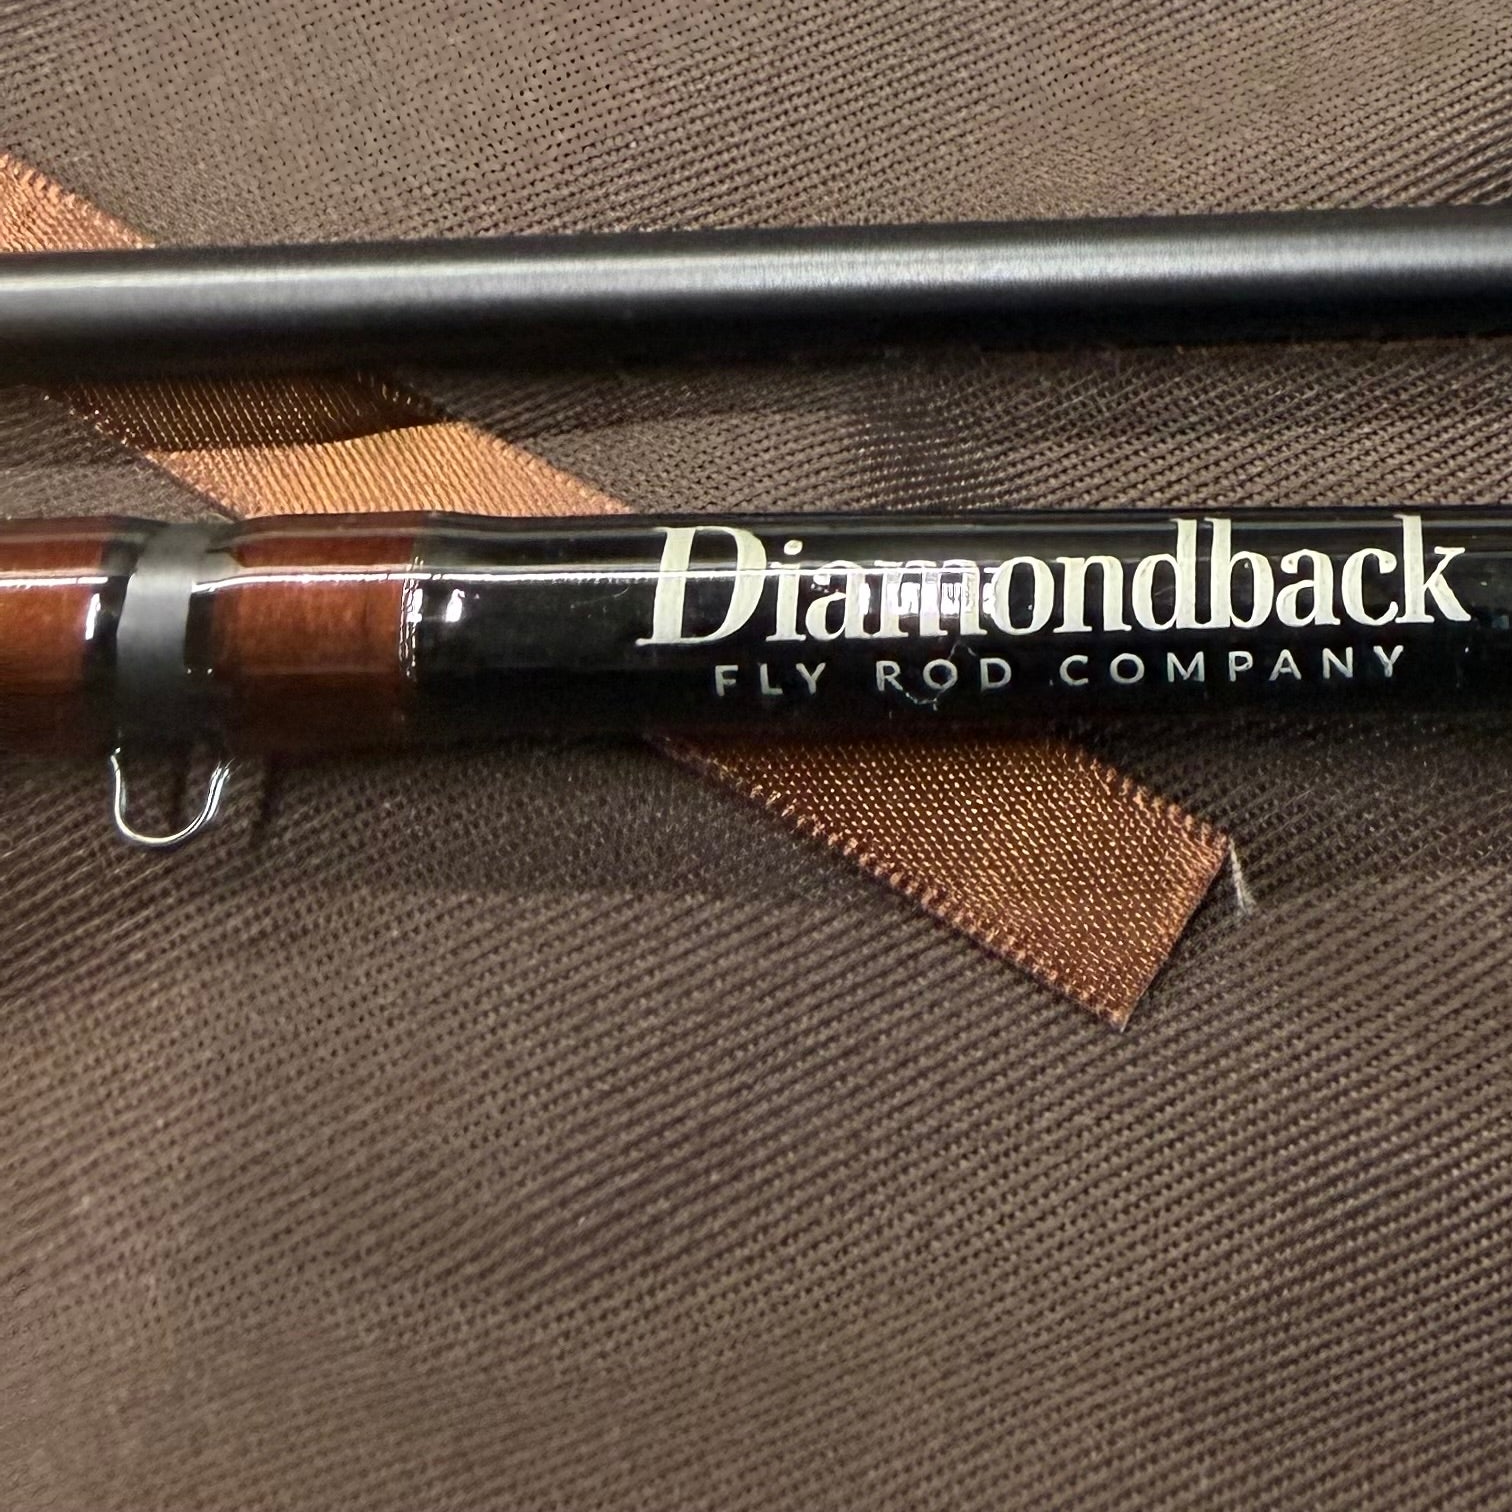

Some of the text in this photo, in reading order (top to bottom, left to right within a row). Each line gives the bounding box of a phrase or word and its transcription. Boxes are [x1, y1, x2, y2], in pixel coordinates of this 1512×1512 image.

[635, 514, 1473, 646] Diamondback
[714, 644, 1405, 697] FLY ROD COMPANY
